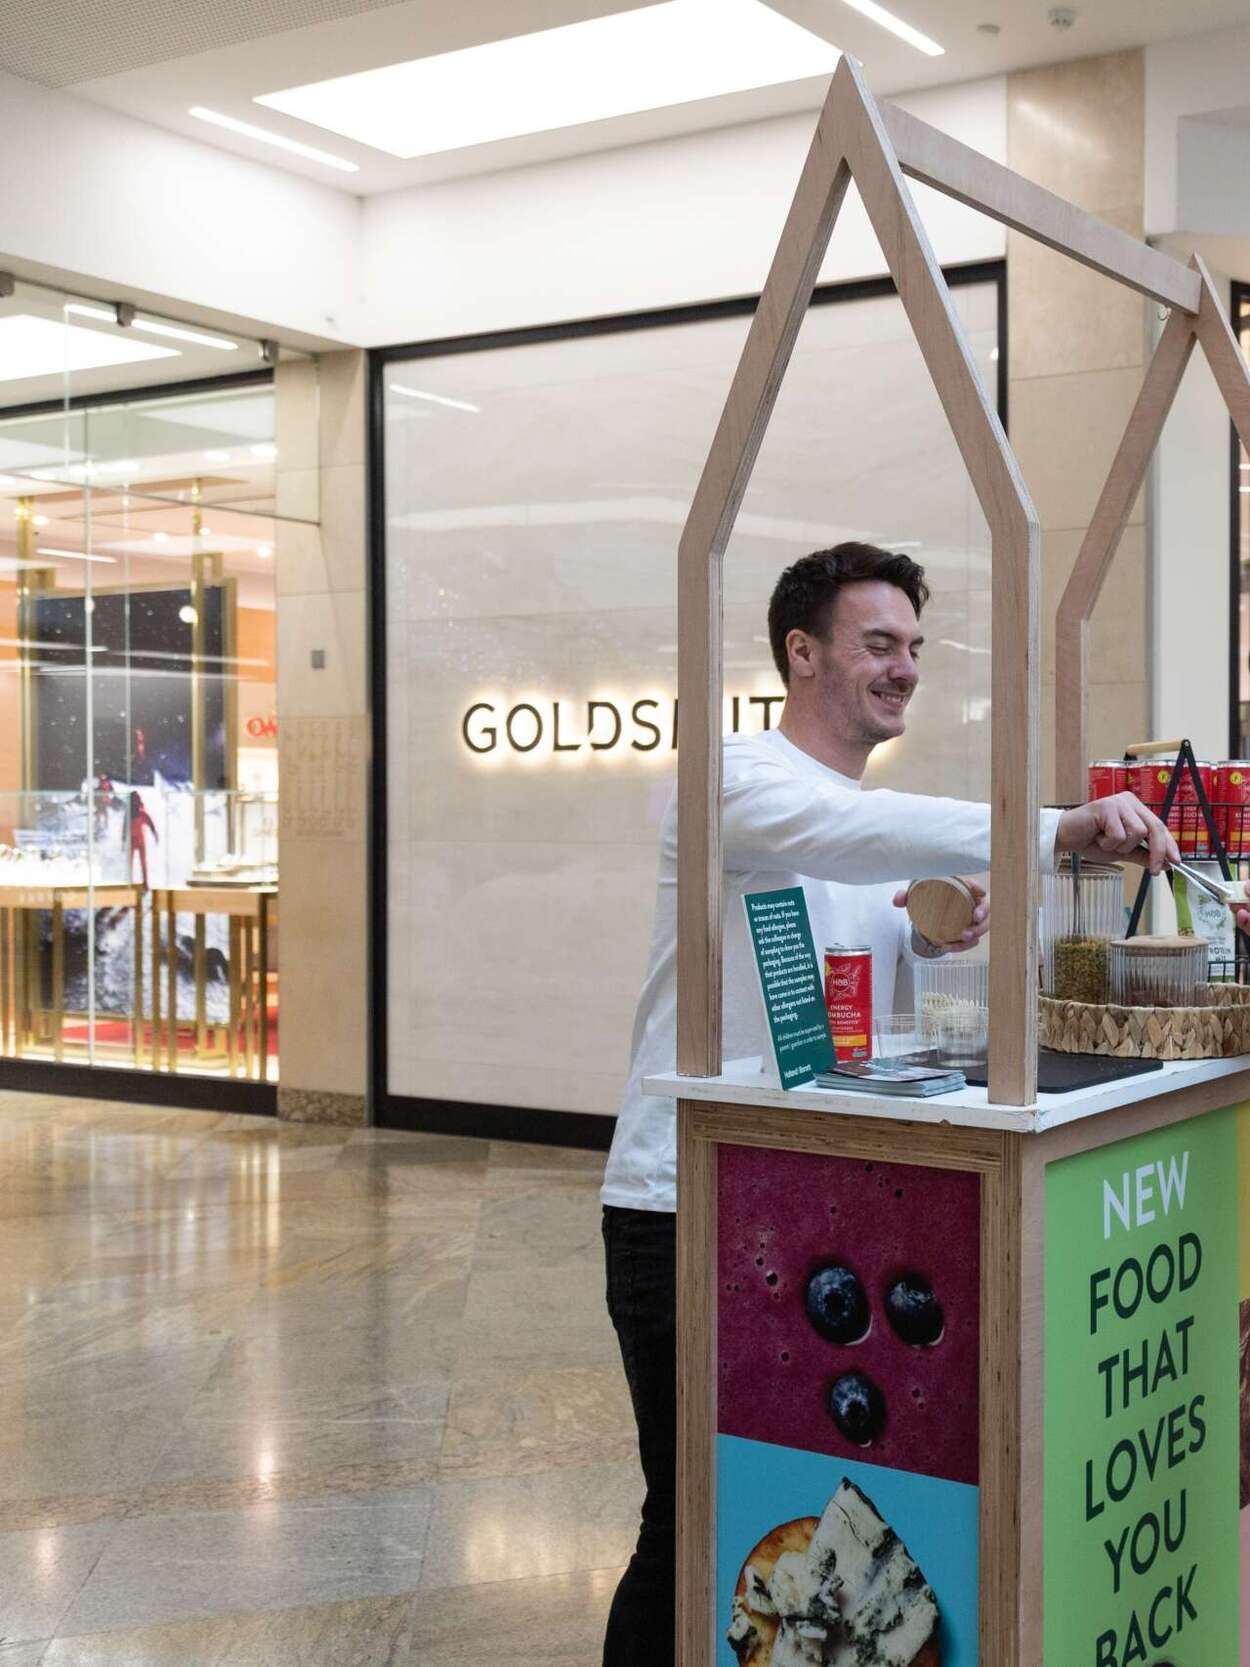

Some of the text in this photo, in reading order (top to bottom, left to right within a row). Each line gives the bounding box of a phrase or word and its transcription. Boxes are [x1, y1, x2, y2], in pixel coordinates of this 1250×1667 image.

[462, 696, 785, 753] GOLDSIT
[1104, 1151, 1189, 1240] NEW
[1090, 1232, 1202, 1335] FOOD
[1098, 1315, 1194, 1418] THAT
[1086, 1394, 1206, 1522] LOVES
[1103, 1488, 1187, 1594] YOU
[1096, 1563, 1198, 1667] BACK
